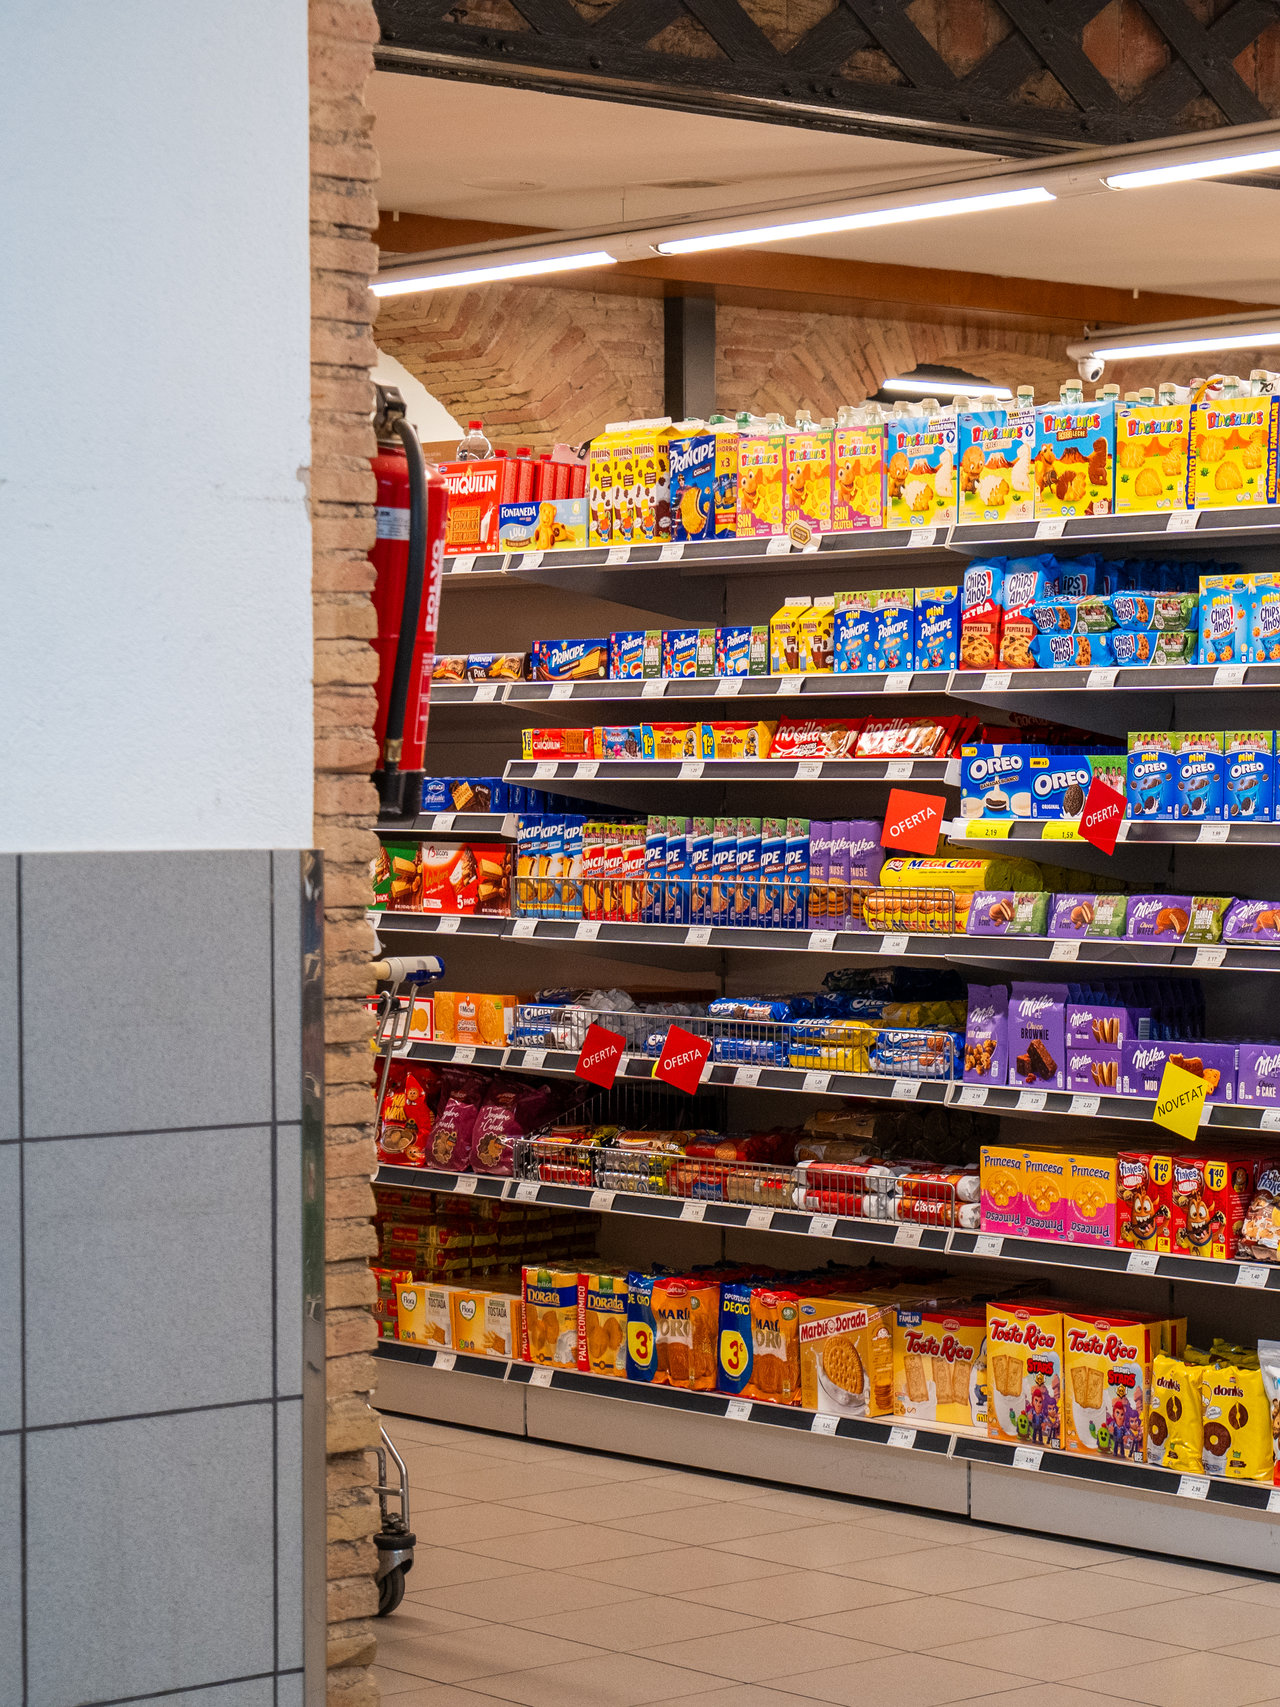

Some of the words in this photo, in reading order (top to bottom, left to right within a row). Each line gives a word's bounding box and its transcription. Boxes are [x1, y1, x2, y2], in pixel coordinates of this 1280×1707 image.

[1270, 402, 1279, 447] FAMILIAR
[1268, 450, 1277, 499] FORMATO
[737, 514, 752, 527] SIN
[834, 506, 849, 520] SIN
[833, 521, 853, 529] GLUTEN
[970, 757, 1023, 776] OREO
[1134, 762, 1167, 776] OREO
[1181, 762, 1215, 777] OREO
[1231, 762, 1264, 776] OREO
[1034, 770, 1089, 796] OREO
[889, 807, 937, 837] OFERTA
[1085, 803, 1120, 827] OFERTA
[1018, 995, 1054, 1017] Milka
[1070, 1013, 1093, 1027] Milka
[1021, 1028, 1049, 1041] BROWNIE
[582, 1045, 617, 1068] OFERTA
[663, 1049, 702, 1070] OFERTA
[1070, 1055, 1092, 1069] Milka
[1132, 1047, 1166, 1069] Milka
[1157, 1085, 1203, 1117] NOVETAT
[1263, 1086, 1276, 1098] CAKE
[984, 1156, 1021, 1170] Princesa
[1025, 1161, 1063, 1175] Princesa
[1071, 1165, 1110, 1180] Princesa
[986, 1211, 1020, 1224] Princesa
[1025, 1216, 1063, 1231] Princesa
[1071, 1222, 1110, 1237] Princesa
[587, 1295, 624, 1310] Dorada
[836, 1311, 866, 1331] Dorada
[989, 1320, 1023, 1342] Tosta
[1023, 1323, 1055, 1349] Rica
[578, 1337, 587, 1361] PACK
[636, 1331, 648, 1359] 3
[728, 1340, 739, 1369] 3
[905, 1330, 938, 1355] Tosta
[941, 1334, 973, 1362] Rica
[1068, 1331, 1103, 1354] Tosta
[1103, 1336, 1137, 1361] Rica
